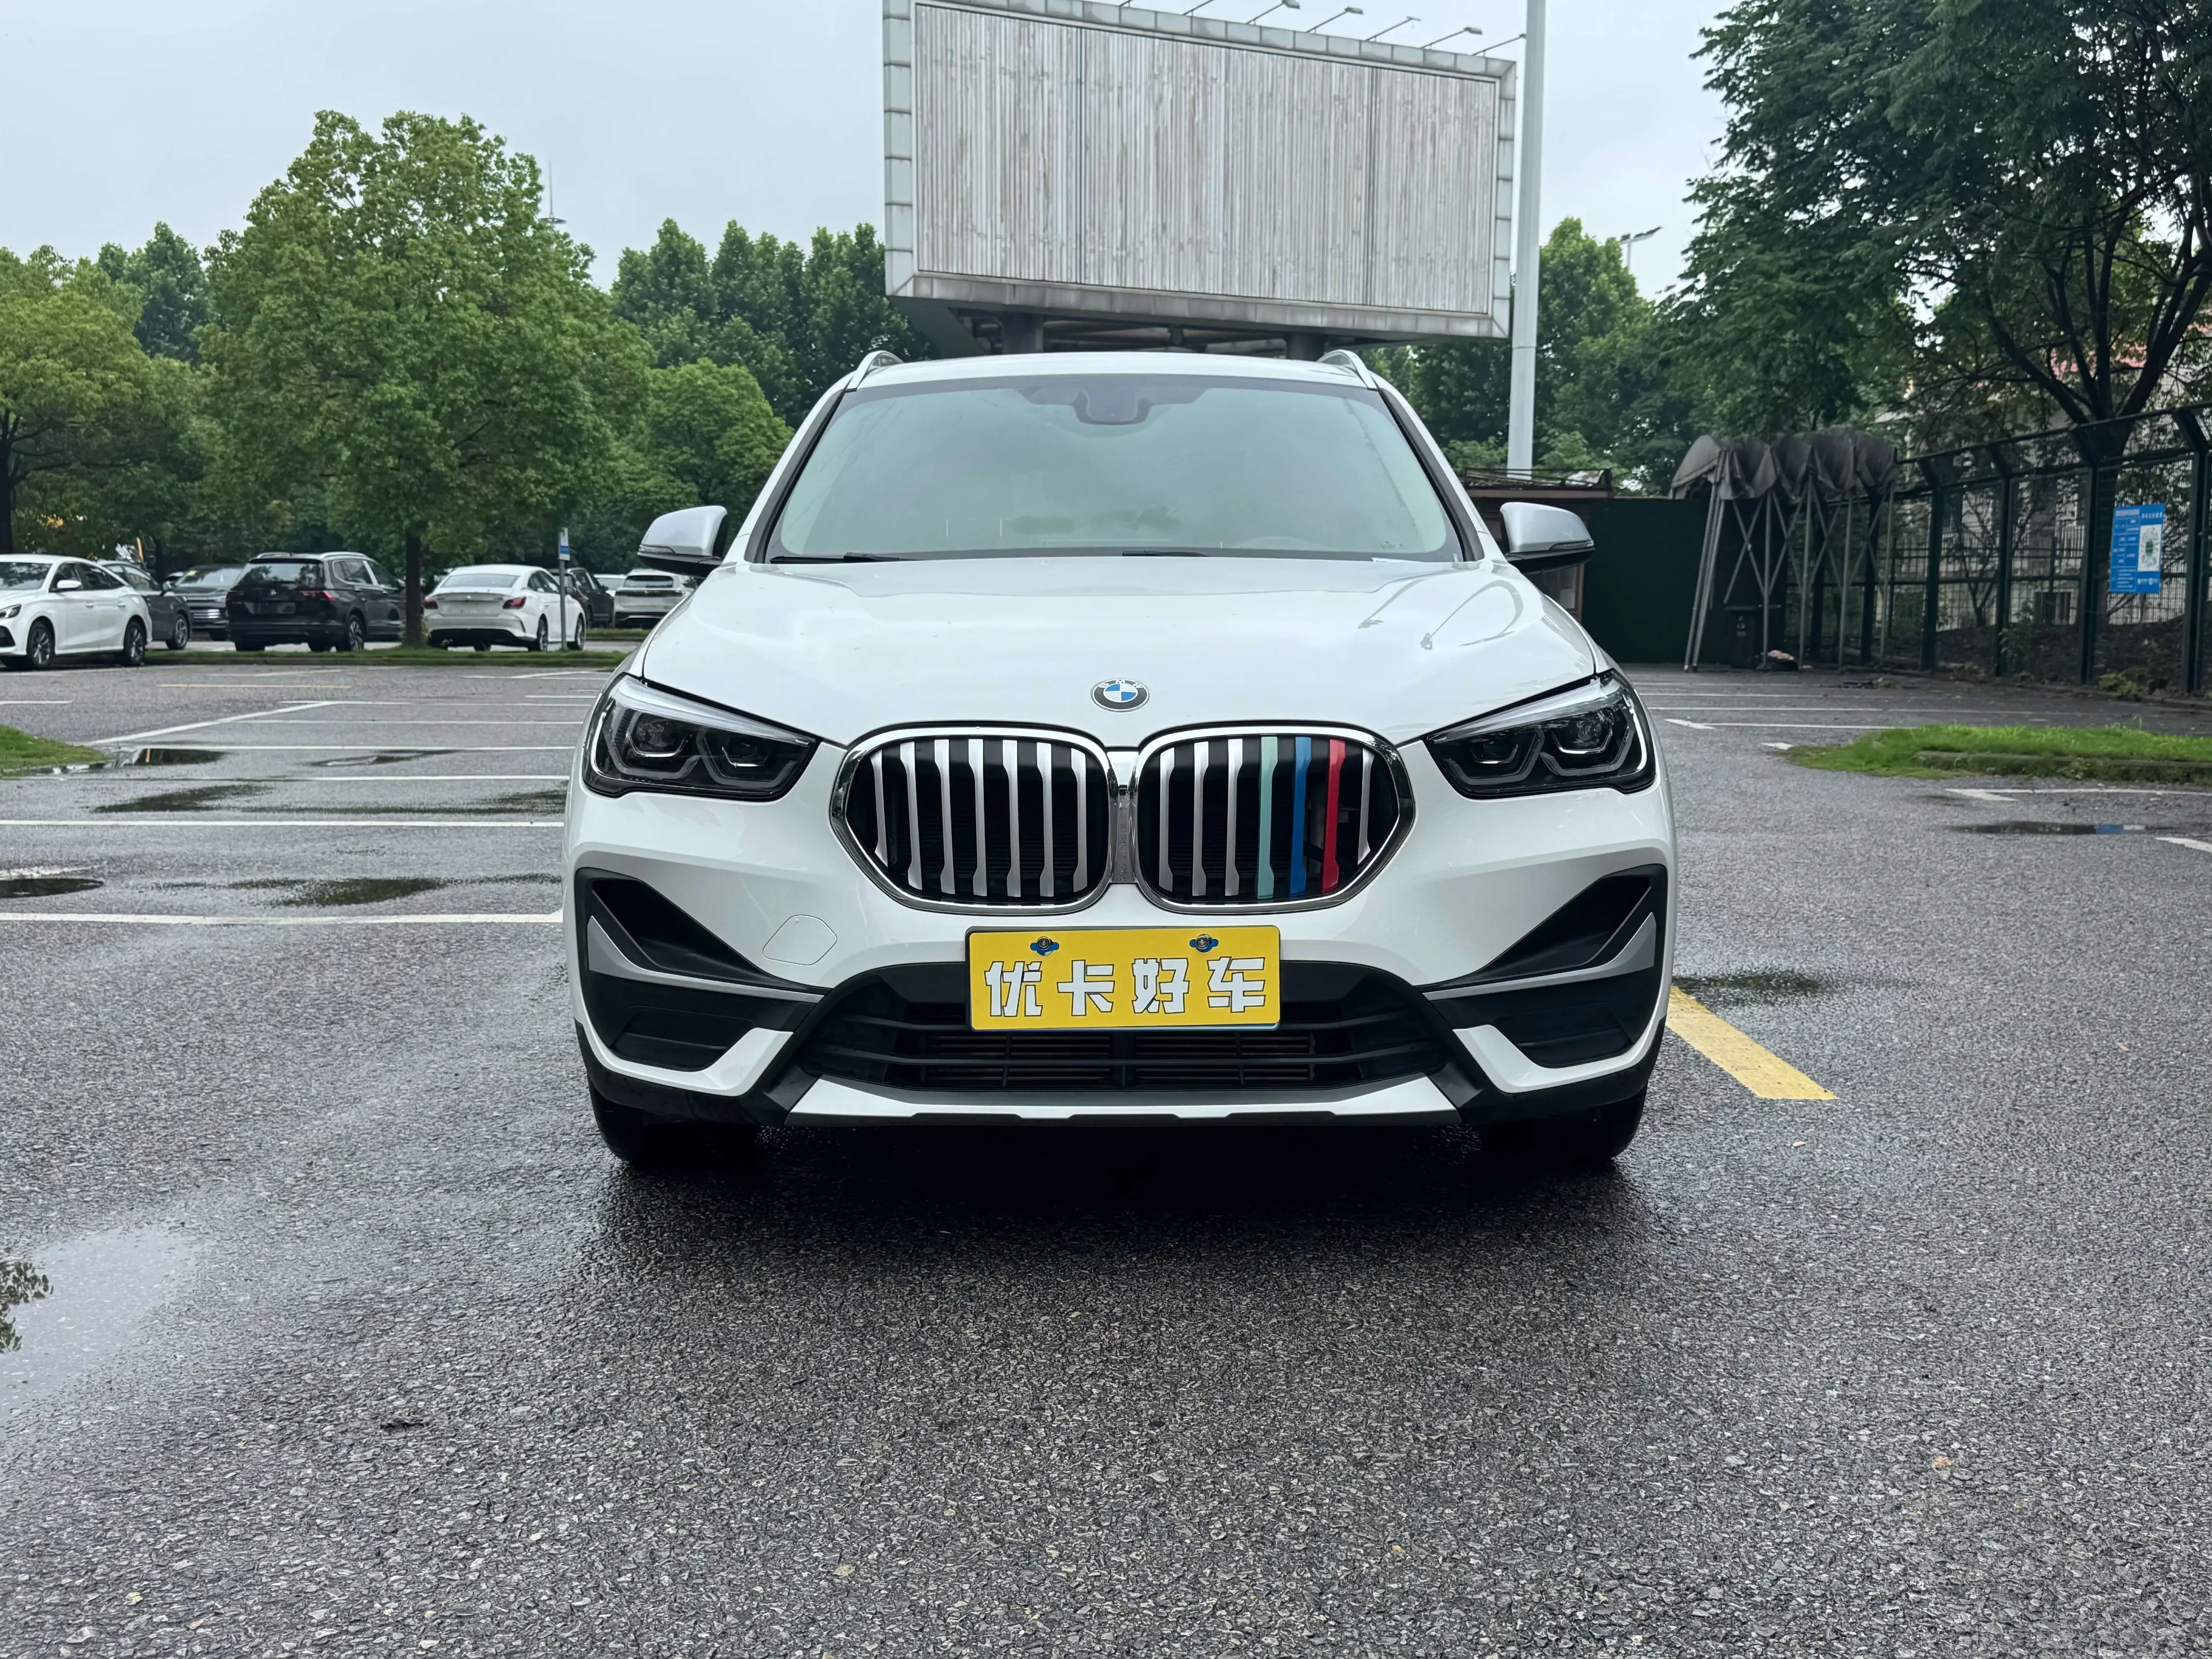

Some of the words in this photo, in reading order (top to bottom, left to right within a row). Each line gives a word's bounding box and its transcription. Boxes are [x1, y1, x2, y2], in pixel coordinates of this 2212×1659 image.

[1098, 679, 1144, 689] BMW
[984, 957, 1266, 1017] 优卡好车
